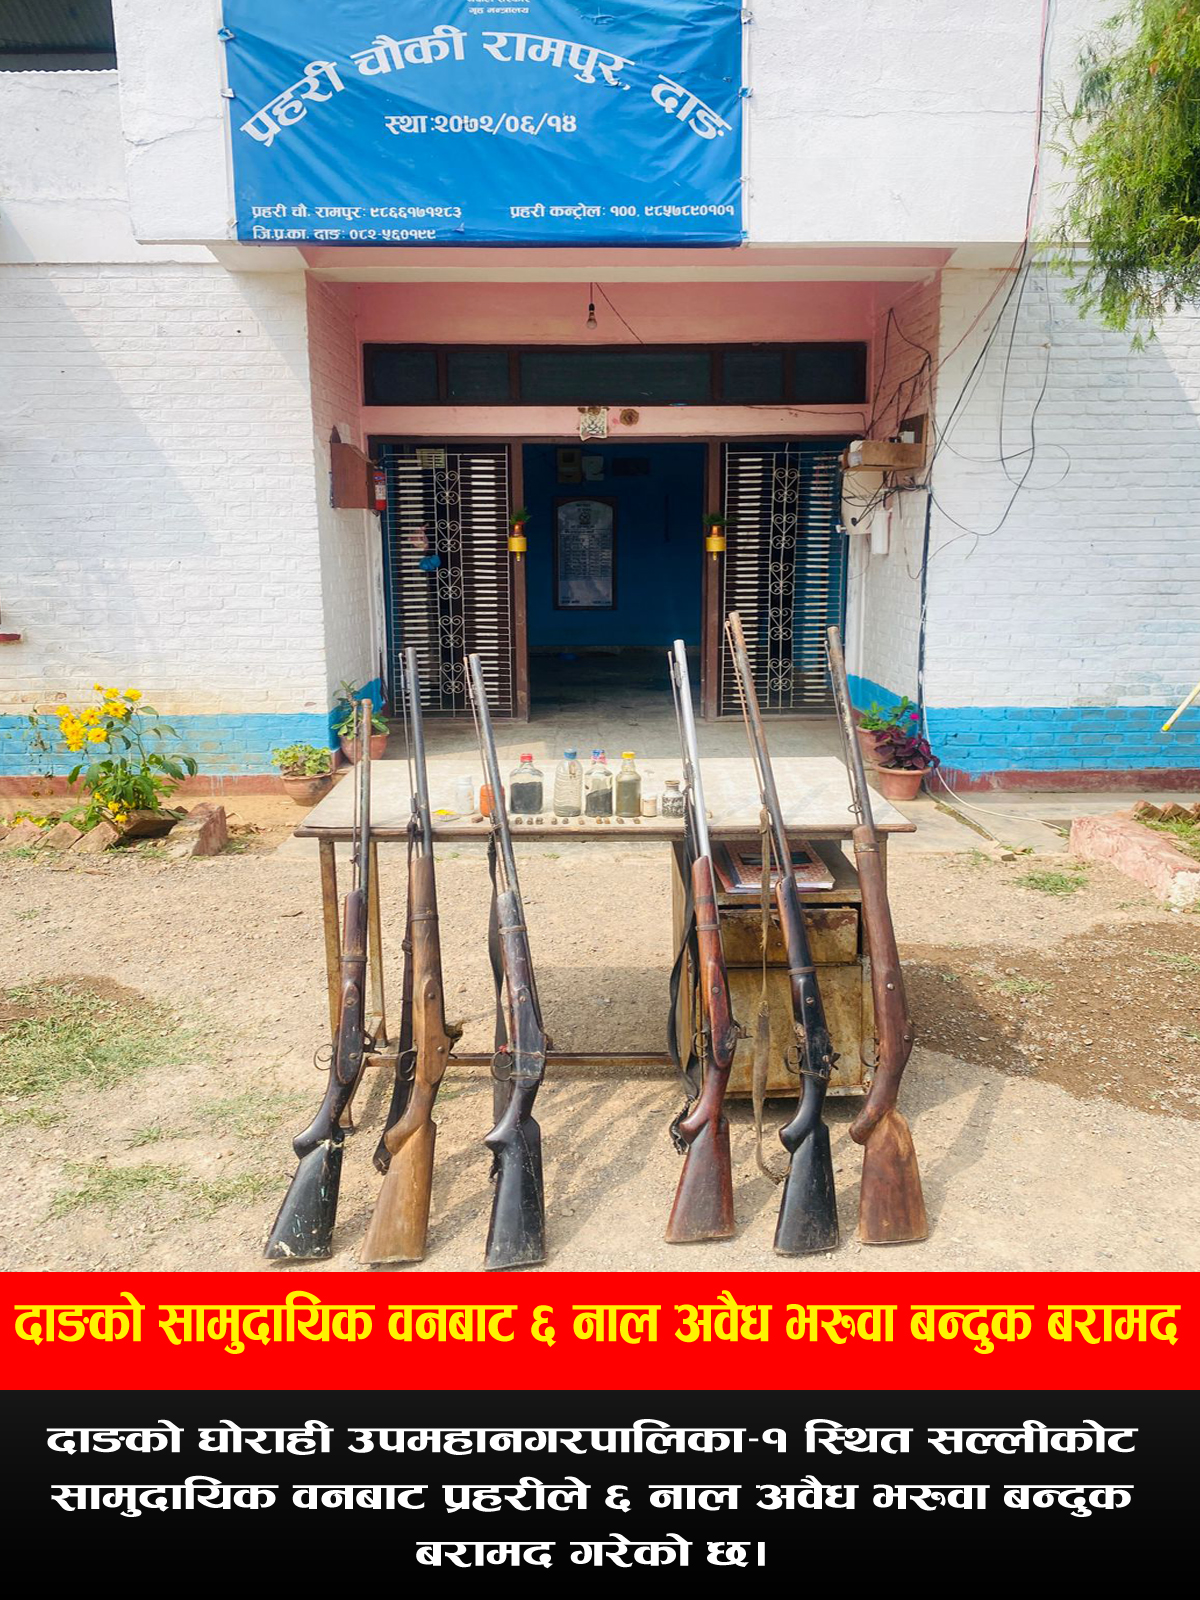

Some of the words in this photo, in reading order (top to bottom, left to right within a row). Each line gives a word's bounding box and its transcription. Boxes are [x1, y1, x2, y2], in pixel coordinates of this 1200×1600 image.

[240, 60, 345, 147] प्रहरी
[350, 24, 467, 76] चौकी
[482, 31, 635, 91] रामपुर,
[651, 74, 733, 140] दाङ
[251, 203, 287, 219] प्रहरी
[291, 203, 311, 218] चौ.
[370, 206, 462, 219] ९८६६१७१२८३
[510, 203, 546, 219] प्रहरी
[644, 204, 735, 217] ९८५७८९०१०१
[349, 229, 436, 241] ०८२-५६०१९९
